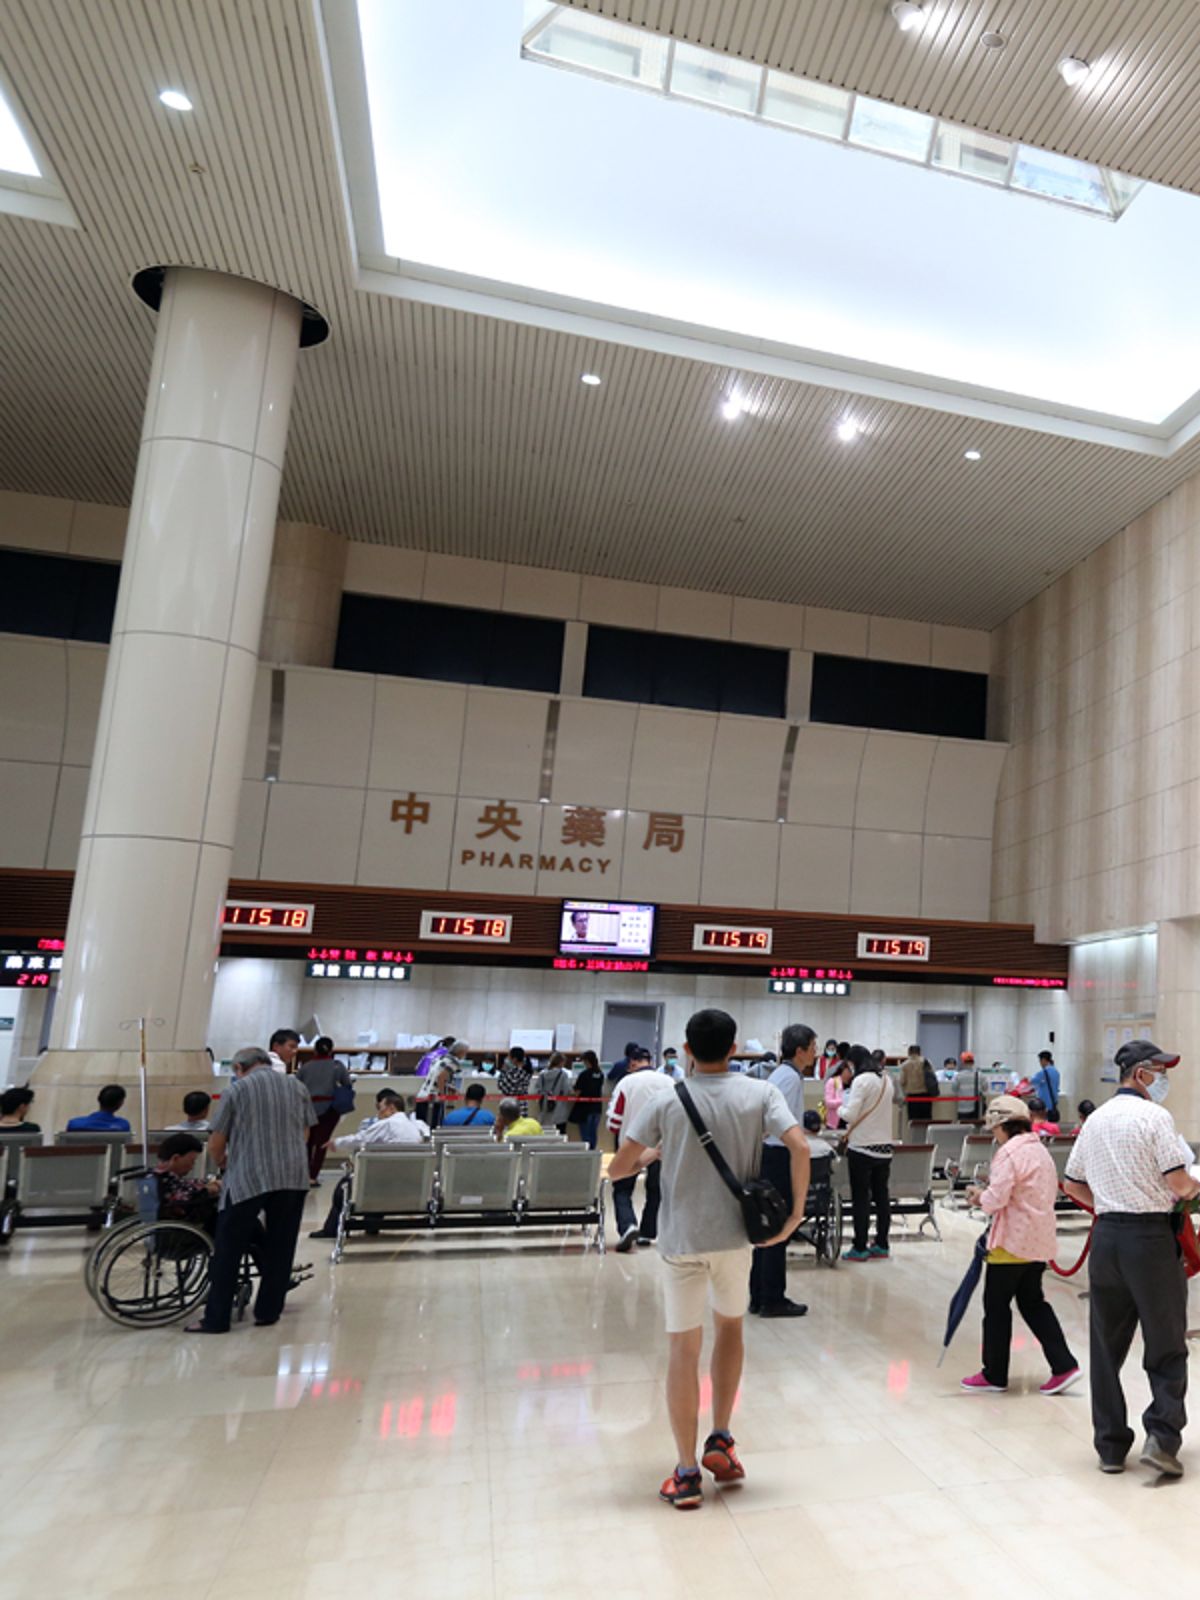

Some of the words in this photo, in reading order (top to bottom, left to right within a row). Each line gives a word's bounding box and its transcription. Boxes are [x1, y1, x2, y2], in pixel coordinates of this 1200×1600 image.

[390, 791, 686, 854] 中央藥局
[461, 849, 612, 874] PHARMACY
